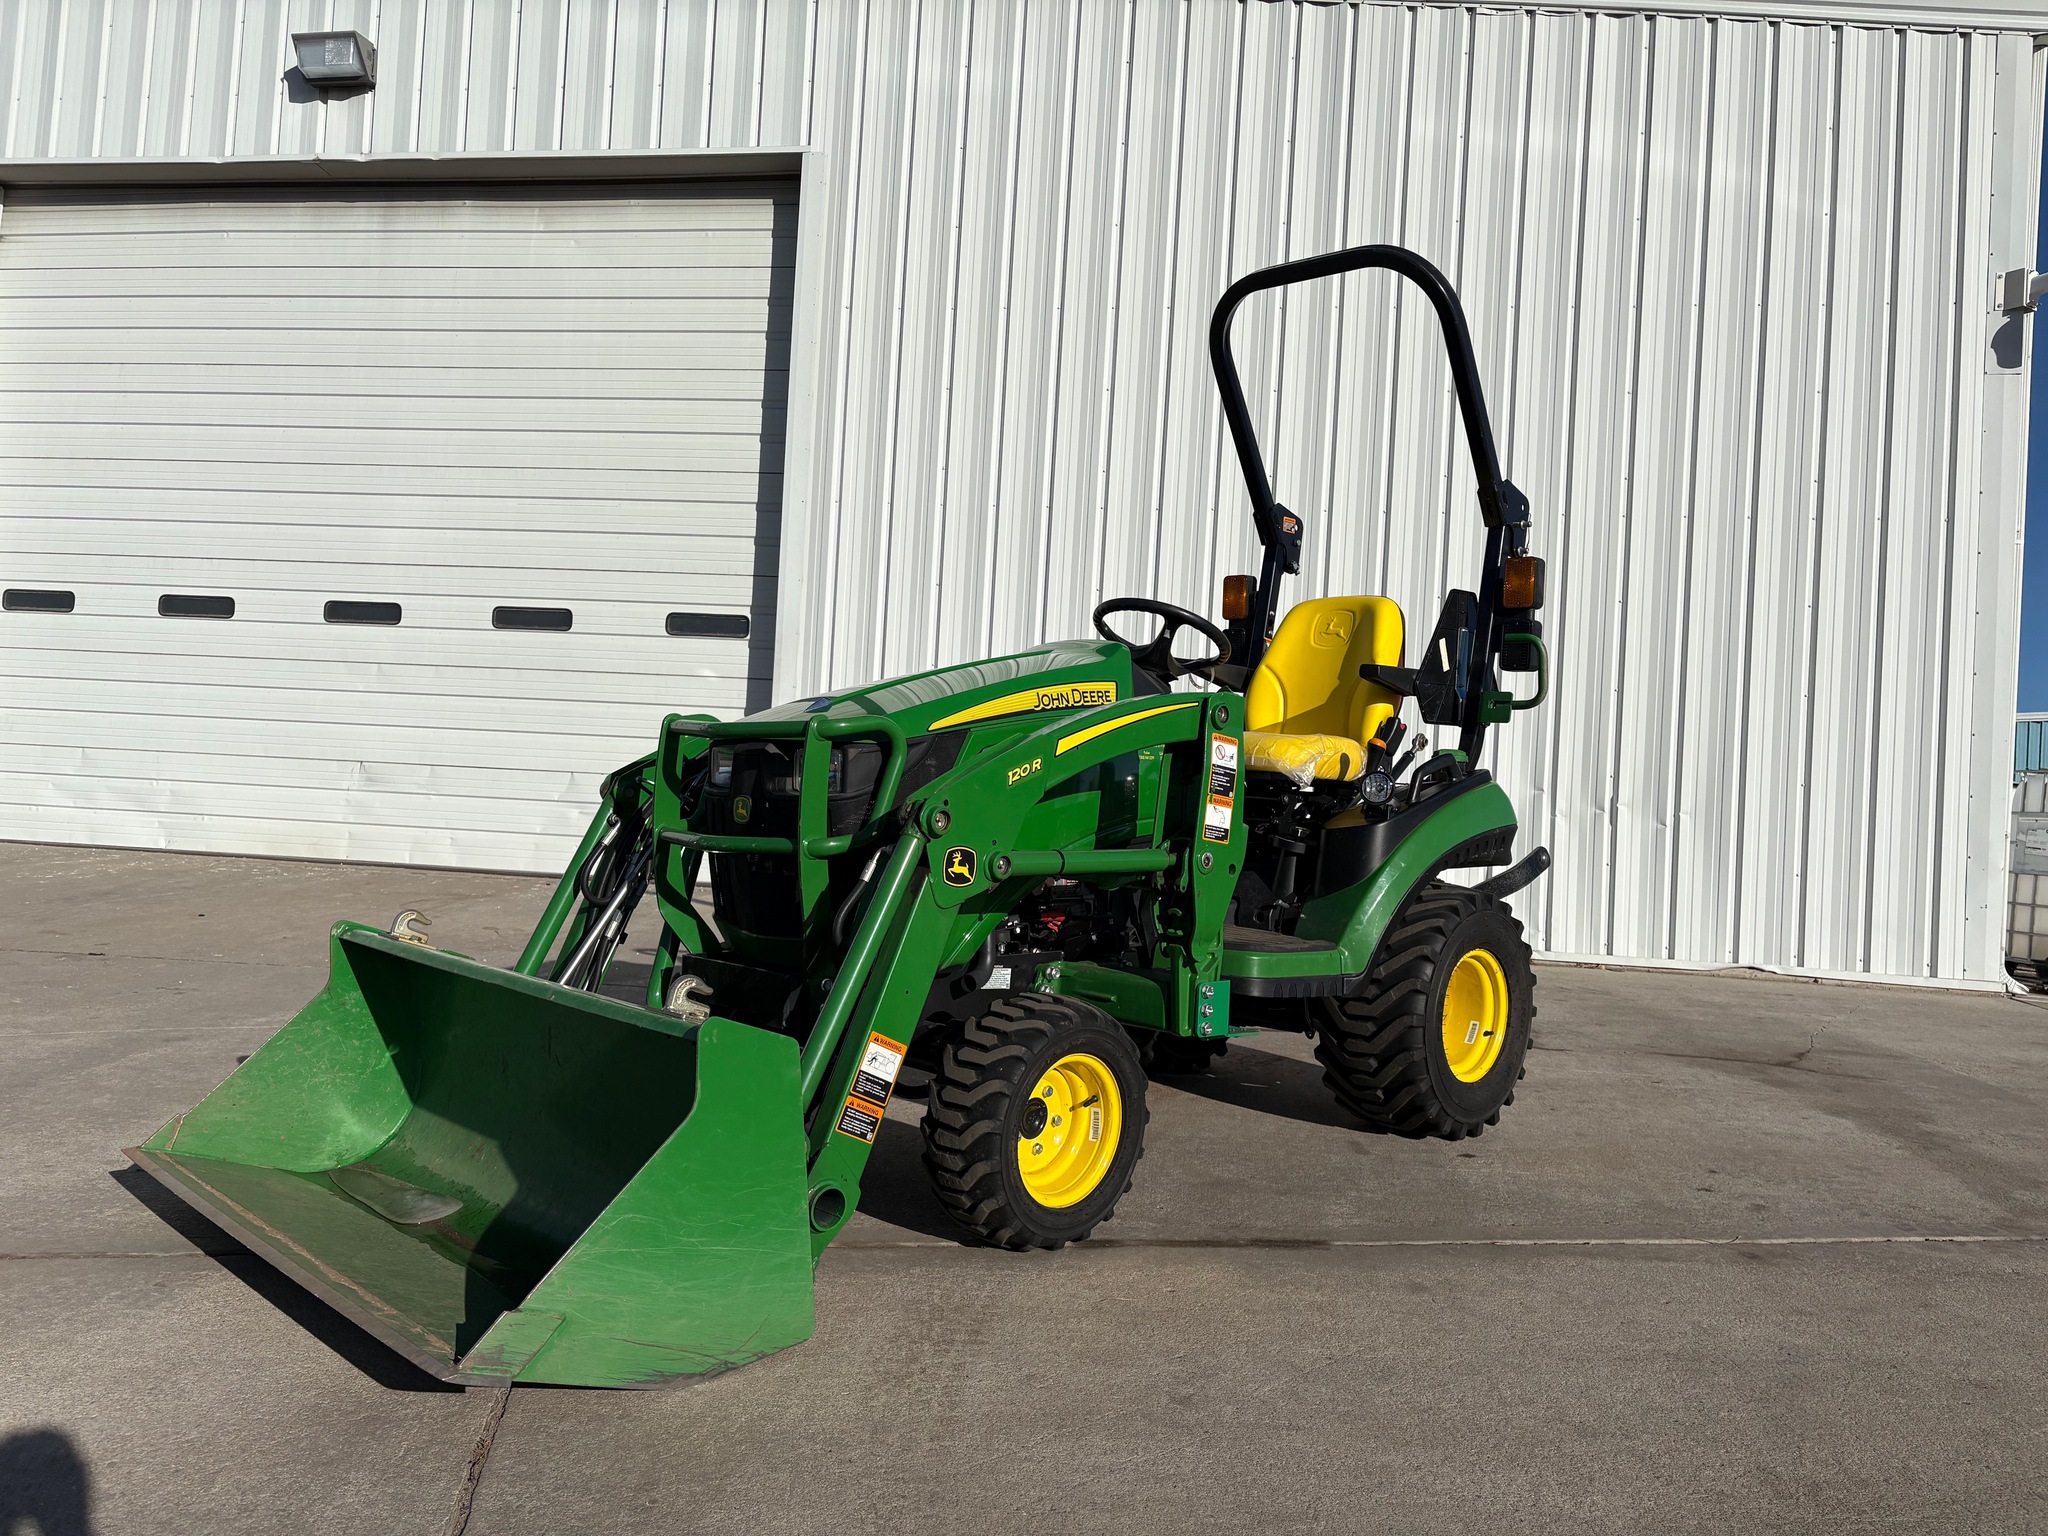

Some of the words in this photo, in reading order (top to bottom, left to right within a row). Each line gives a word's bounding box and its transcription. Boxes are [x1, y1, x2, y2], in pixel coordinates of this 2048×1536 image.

[1034, 692, 1070, 709] JOHN
[1071, 688, 1112, 705] DEERE
[1218, 735, 1237, 746] WARNING
[1008, 763, 1030, 786] 120
[1032, 757, 1042, 773] R
[1213, 798, 1232, 807] WARNING
[880, 1038, 902, 1053] WARNING
[856, 1102, 879, 1116] WARNING
